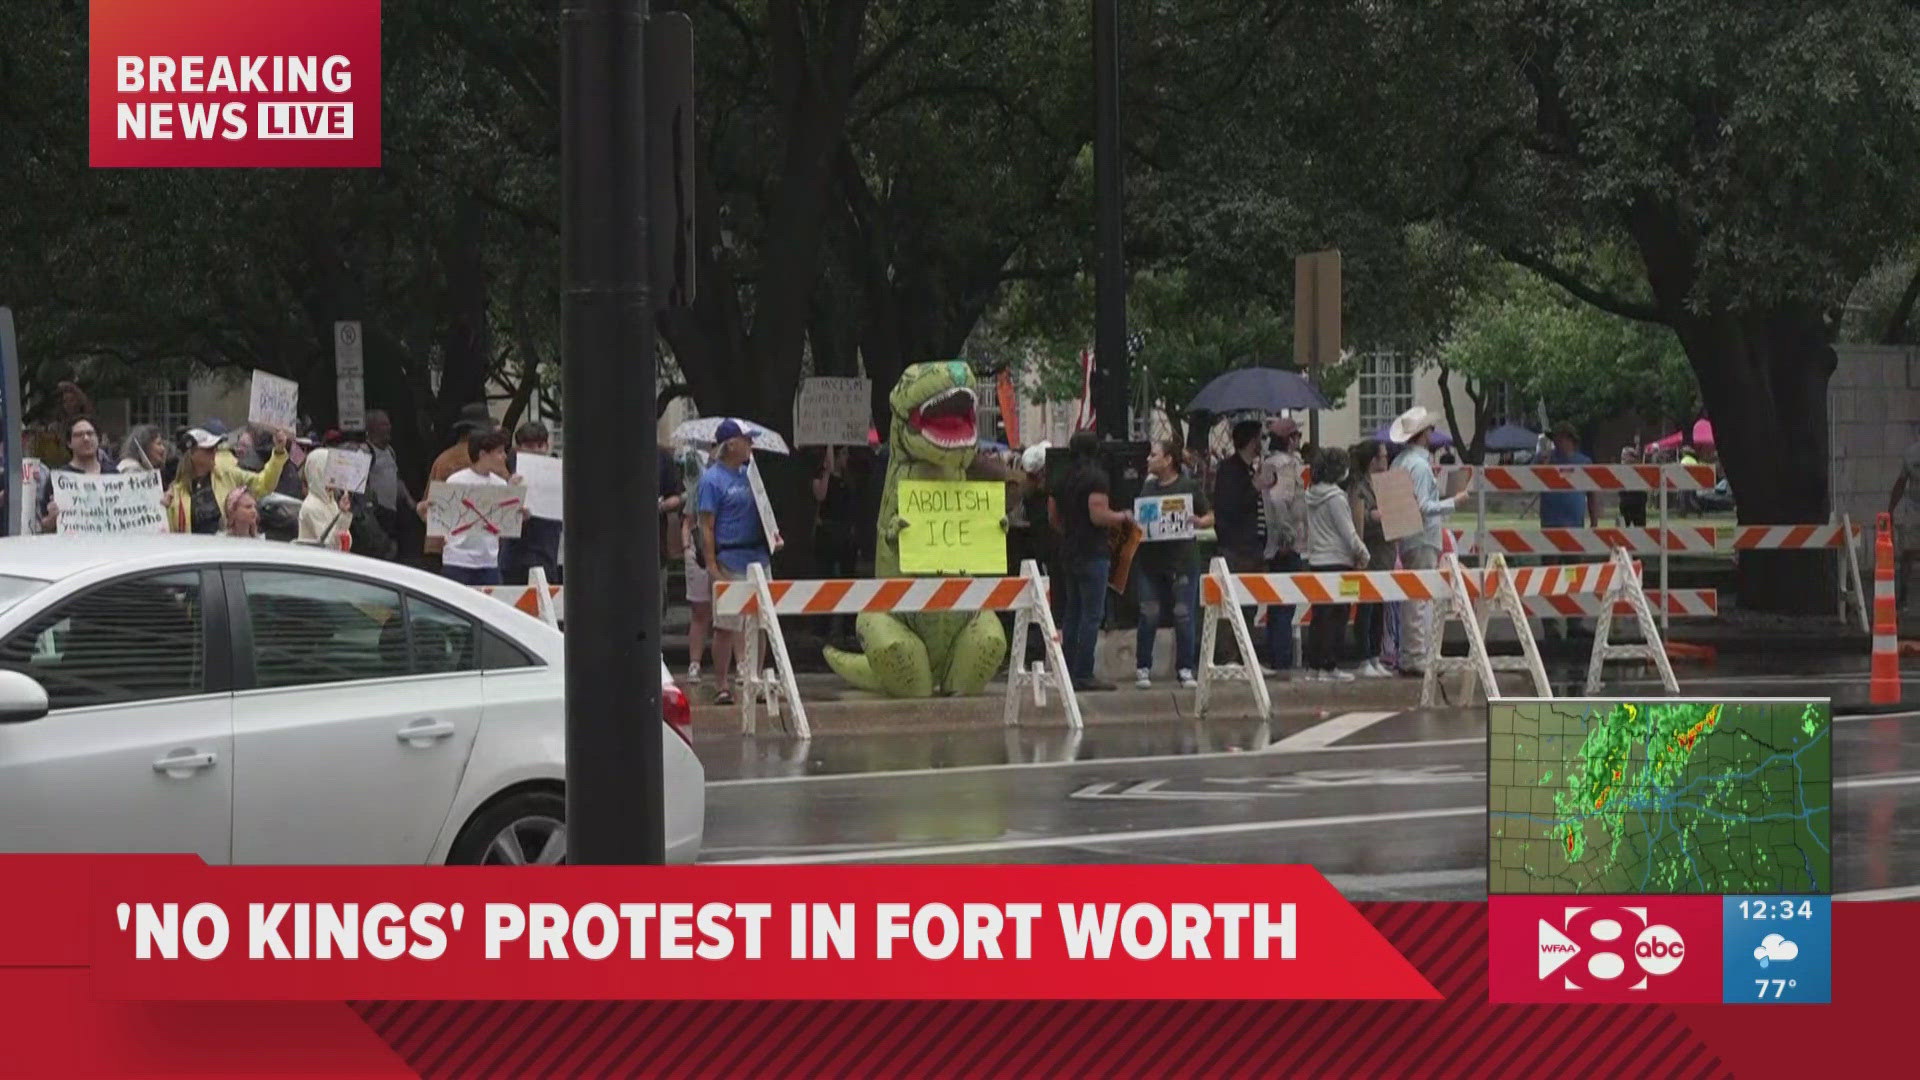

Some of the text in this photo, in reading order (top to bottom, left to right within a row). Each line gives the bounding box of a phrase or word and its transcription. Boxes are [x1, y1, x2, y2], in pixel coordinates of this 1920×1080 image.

[58, 475, 78, 490] Give
[128, 473, 159, 490] tired
[906, 489, 990, 513] ABOLISH
[925, 518, 973, 547] ICE
